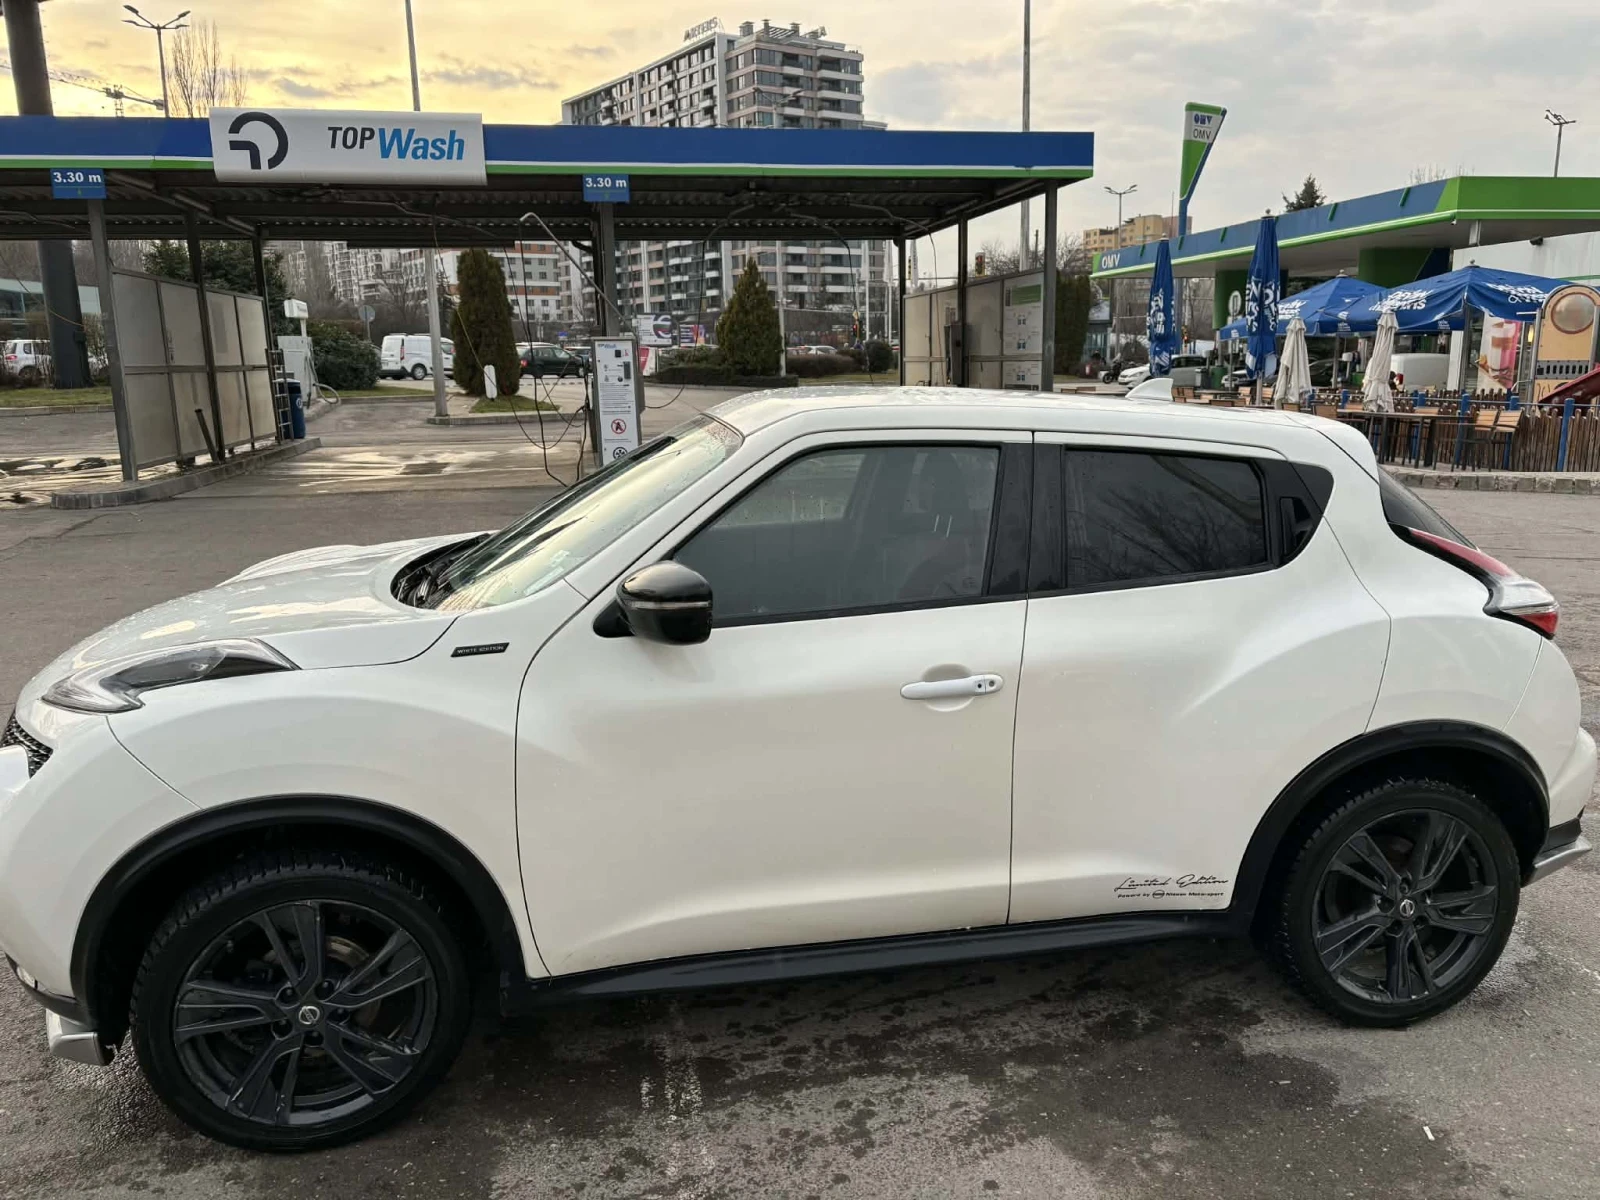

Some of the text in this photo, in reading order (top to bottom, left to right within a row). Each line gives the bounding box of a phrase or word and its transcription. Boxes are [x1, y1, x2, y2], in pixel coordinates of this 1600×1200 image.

[1193, 128, 1212, 140] OMV
[53, 171, 102, 183] 3.30 m
[585, 177, 627, 188] 3.30 m
[1101, 253, 1121, 269] OMV
[1113, 874, 1229, 892] Limited Edition
